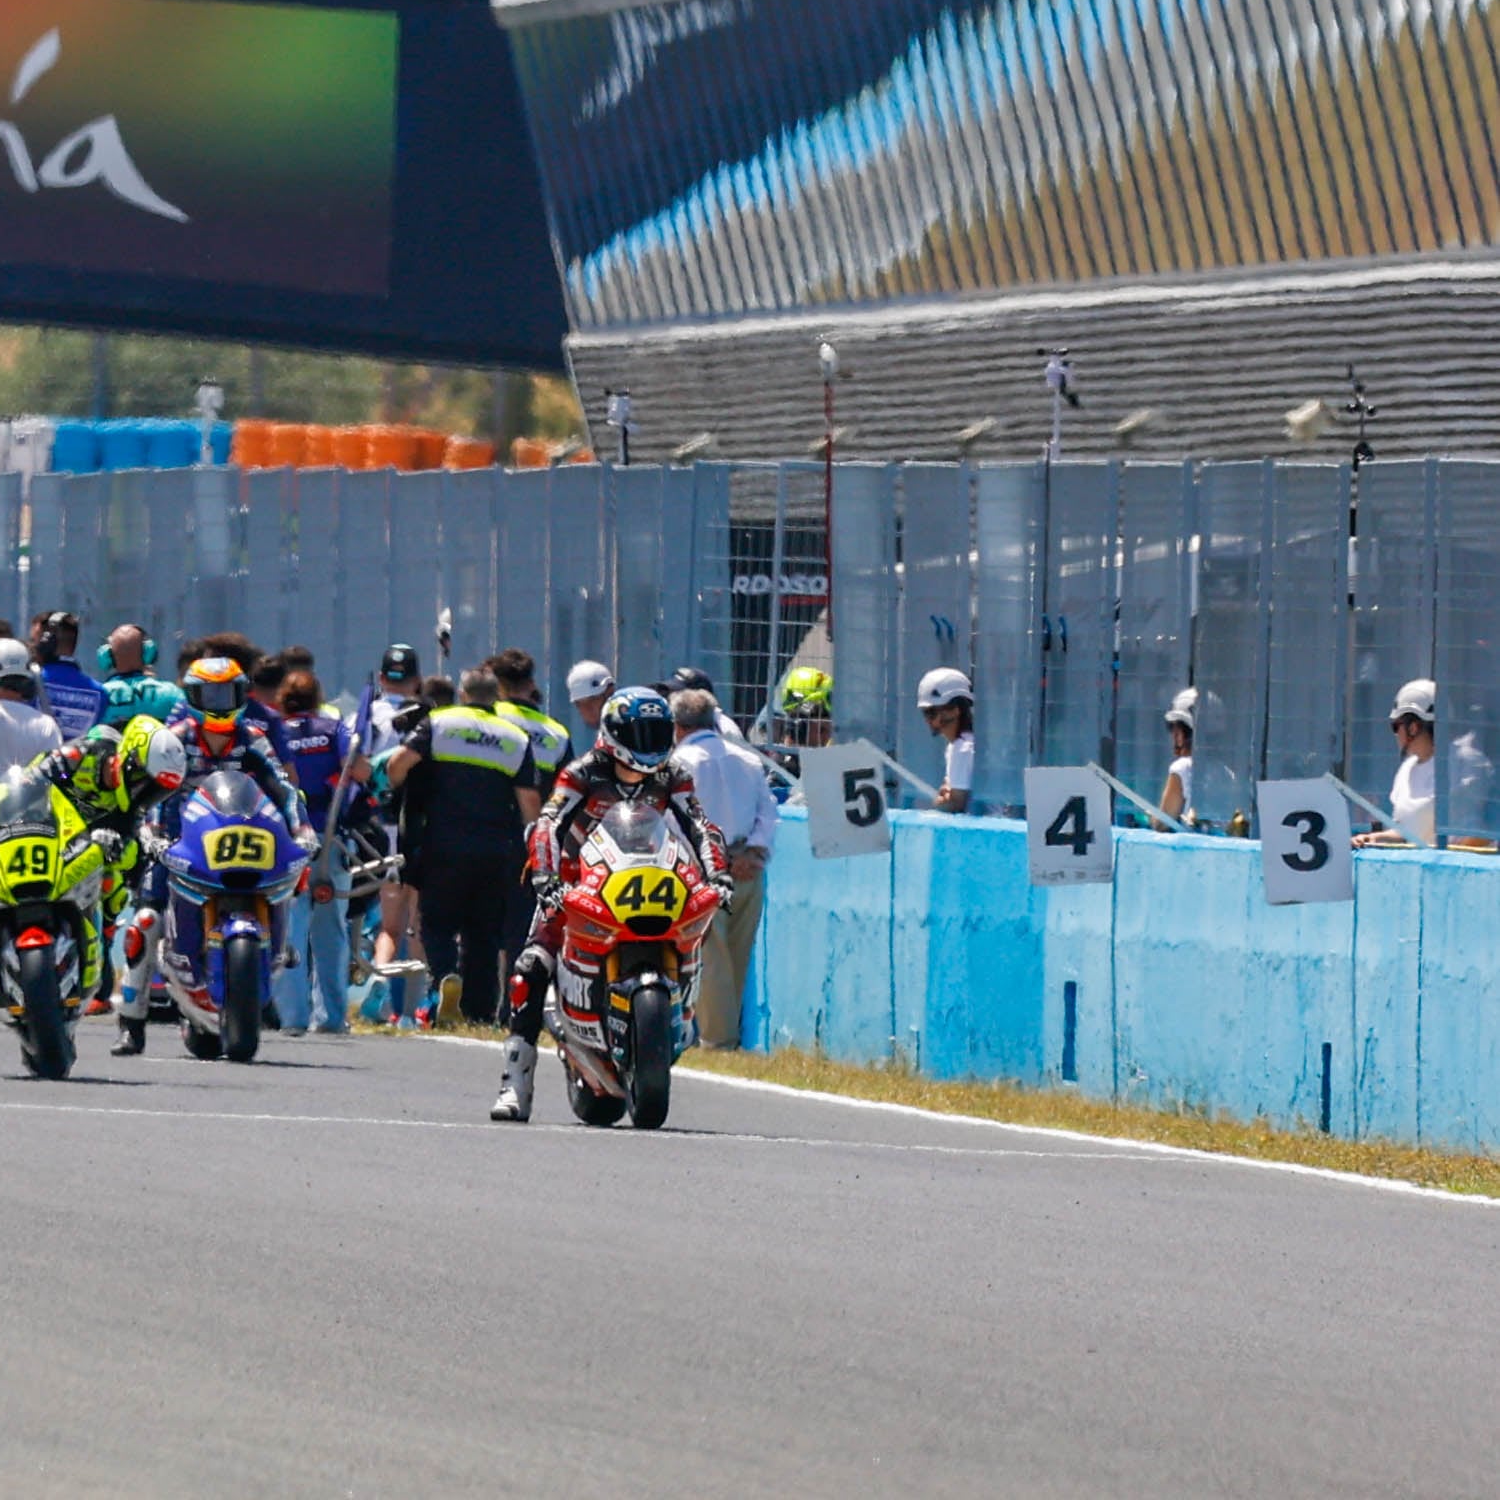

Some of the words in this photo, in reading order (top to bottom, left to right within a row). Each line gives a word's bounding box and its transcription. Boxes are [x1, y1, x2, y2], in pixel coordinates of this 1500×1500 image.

[843, 768, 883, 828] 5
[1045, 796, 1095, 856] 4
[7, 844, 50, 876] 49
[1281, 810, 1329, 872] 3
[615, 875, 680, 912] 44
